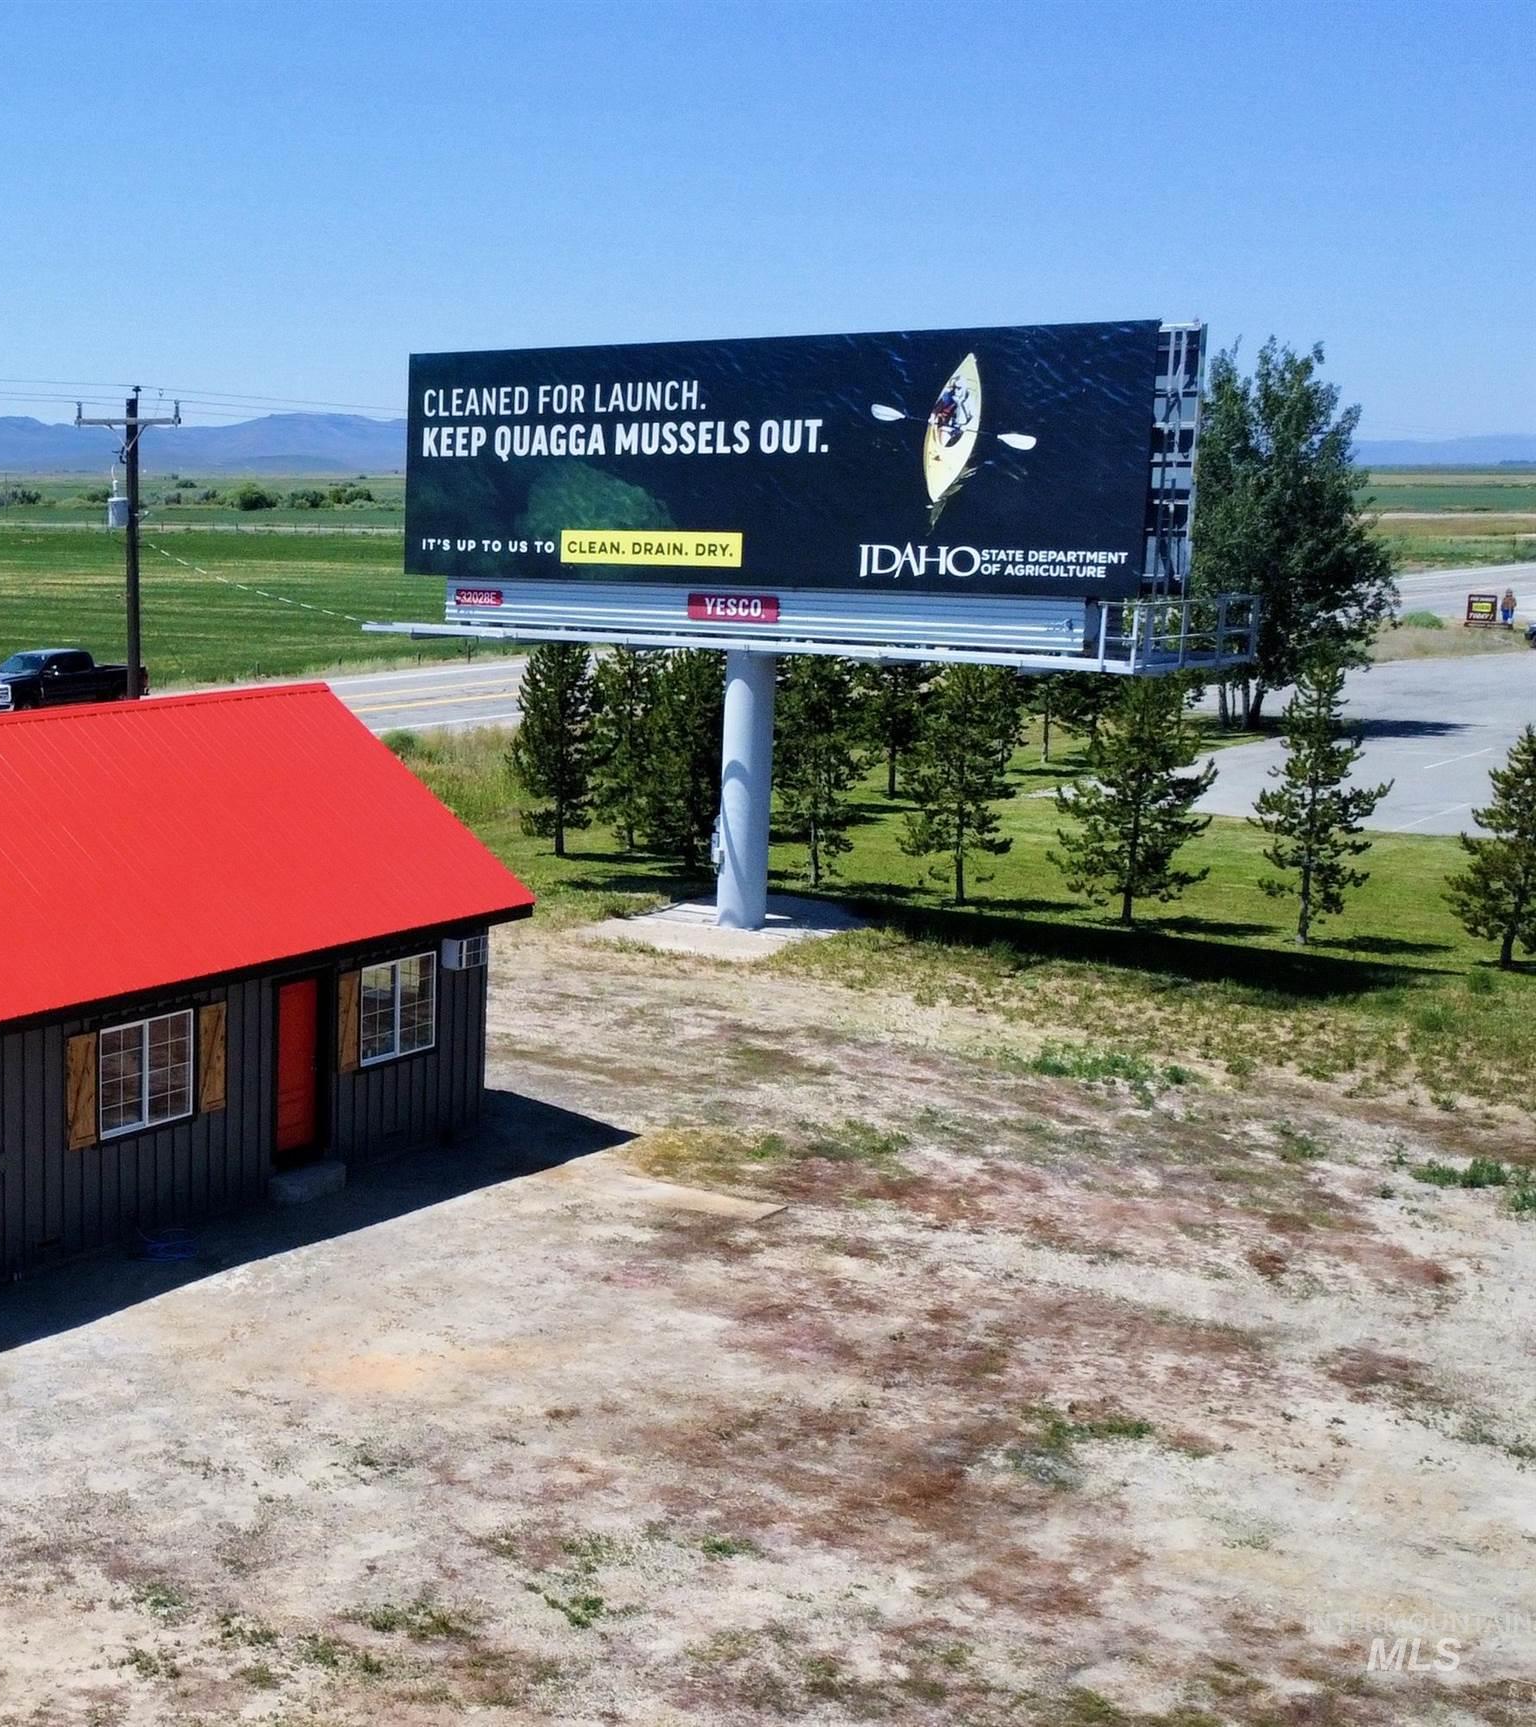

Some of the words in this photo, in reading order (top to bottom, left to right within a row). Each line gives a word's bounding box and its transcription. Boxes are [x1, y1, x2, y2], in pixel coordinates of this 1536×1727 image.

[423, 386, 529, 417] CLEANED
[538, 384, 585, 414] FOR
[594, 380, 706, 413] LAUNCH.
[422, 426, 487, 457] KEEP
[494, 423, 606, 462] QUAGGA
[615, 420, 750, 455] MUSSELS
[760, 419, 829, 454] OUT.
[422, 538, 451, 551] IT'S
[456, 539, 477, 552] UP
[482, 540, 502, 552] TO
[508, 540, 528, 553] US
[534, 541, 555, 553] TO
[567, 540, 626, 554] CLEAN.
[631, 542, 689, 556] DRAIN.
[695, 543, 734, 557] DRY.
[859, 542, 981, 579] IDAHO
[981, 549, 1024, 562] STATE
[1028, 550, 1129, 565] DEPARTMENT
[980, 563, 1001, 576] OF
[1004, 564, 1107, 578] AGRICULTURE
